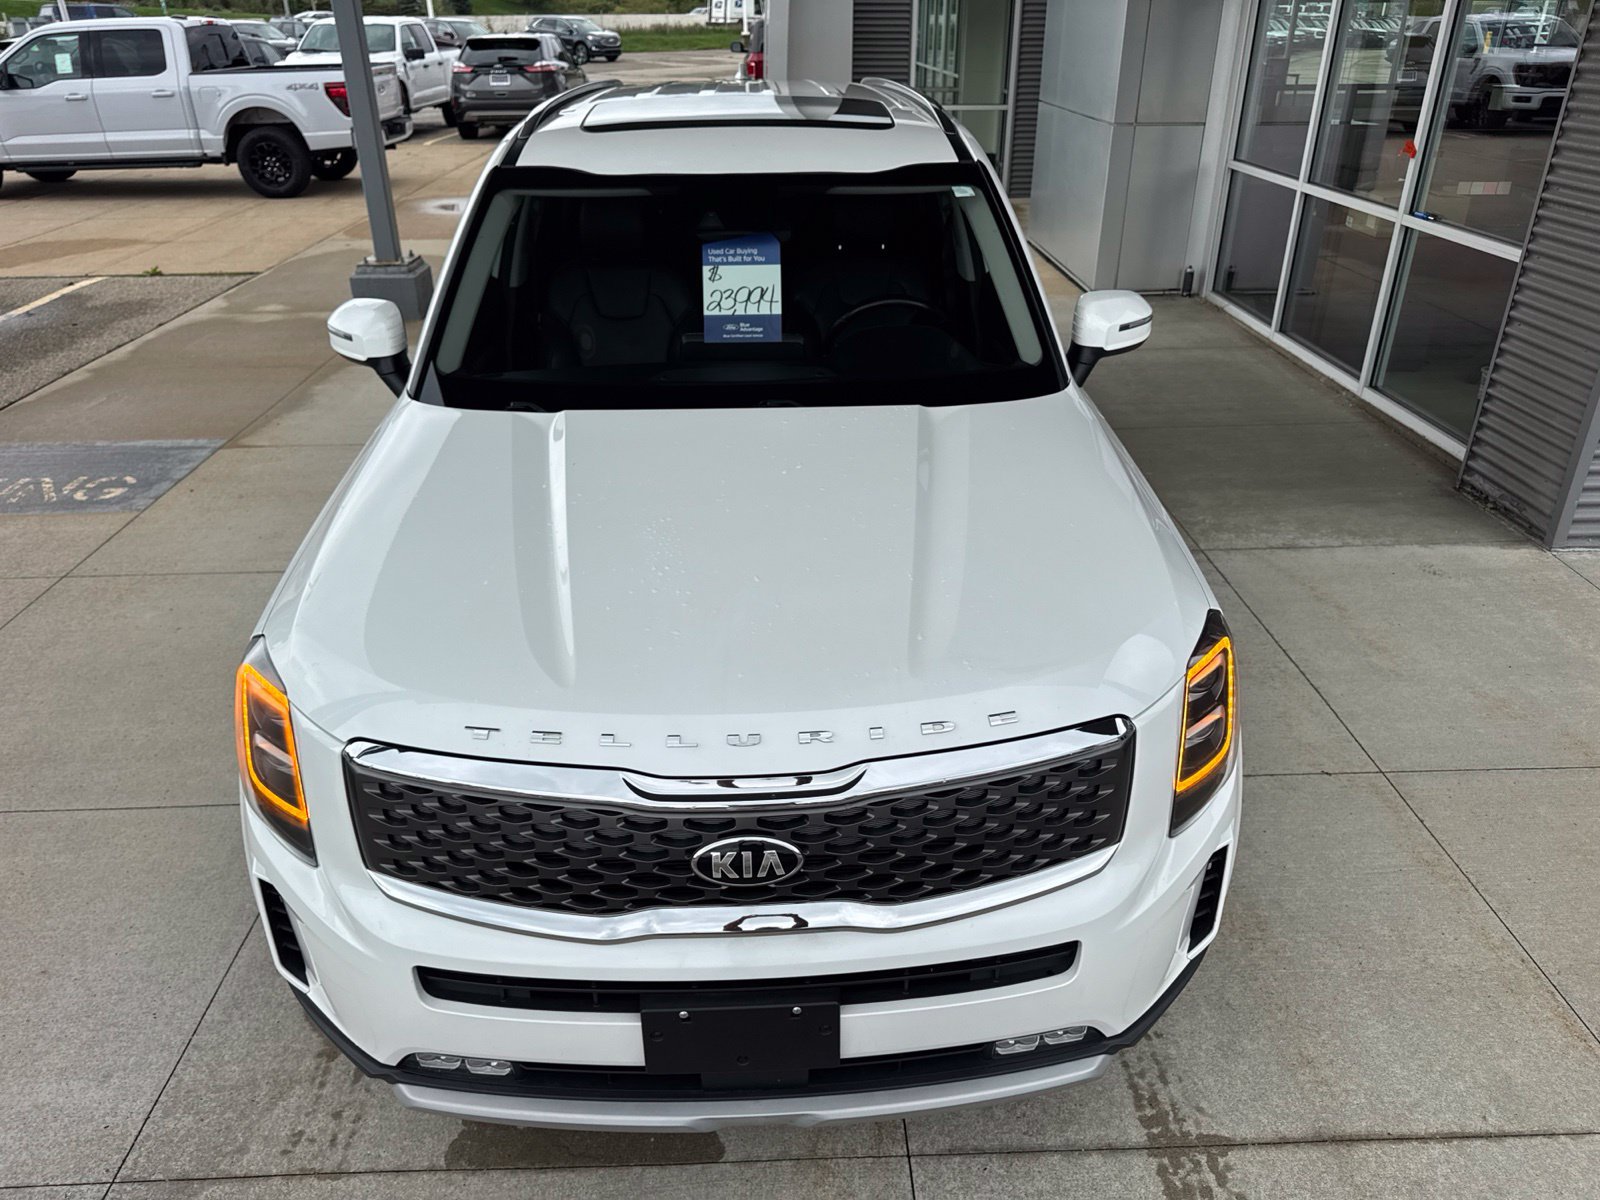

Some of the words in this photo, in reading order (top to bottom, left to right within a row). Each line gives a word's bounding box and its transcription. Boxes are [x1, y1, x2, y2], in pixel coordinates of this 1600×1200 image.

[725, 247, 735, 255] Car
[736, 247, 758, 256] Buying
[708, 265, 722, 283] $
[706, 284, 779, 316] 23,994
[0, 475, 138, 503] NG
[464, 710, 1019, 748] TELLURIDE
[710, 850, 786, 878] KIA
